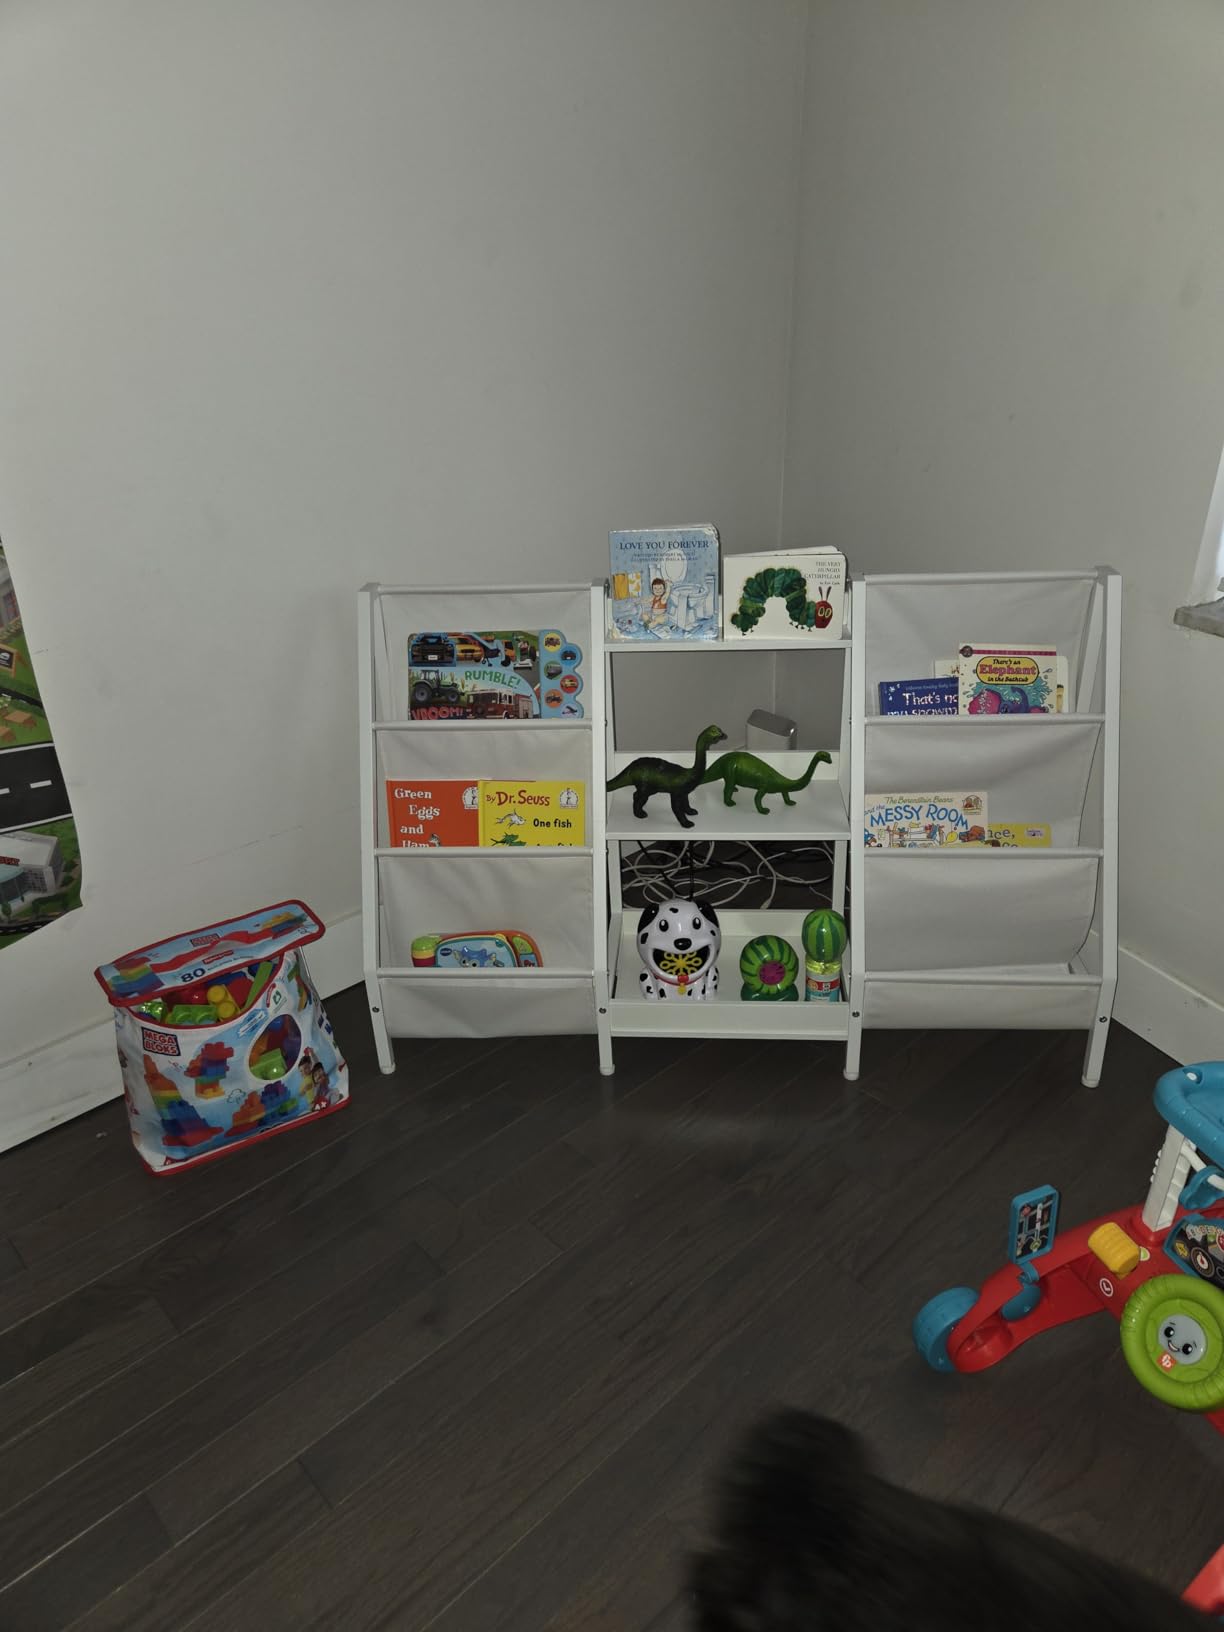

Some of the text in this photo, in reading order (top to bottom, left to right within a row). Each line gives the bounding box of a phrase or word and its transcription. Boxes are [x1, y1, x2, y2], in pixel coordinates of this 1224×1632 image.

[620, 540, 709, 550] LOVE YOU FOREVER
[979, 663, 1036, 676] Elephant
[464, 669, 521, 689] RUMBLE!
[902, 691, 959, 706] That's no
[411, 706, 464, 720] VROOM!
[394, 787, 432, 799] Green
[486, 789, 551, 807] By Dr. Seuss
[408, 804, 441, 820] Eggs
[870, 803, 968, 830] MESSY ROOM
[400, 824, 424, 834] and
[533, 818, 572, 828] One fish
[181, 967, 206, 983] 80
[143, 1029, 176, 1044] MEGA
[144, 1040, 178, 1054] BLOKS
